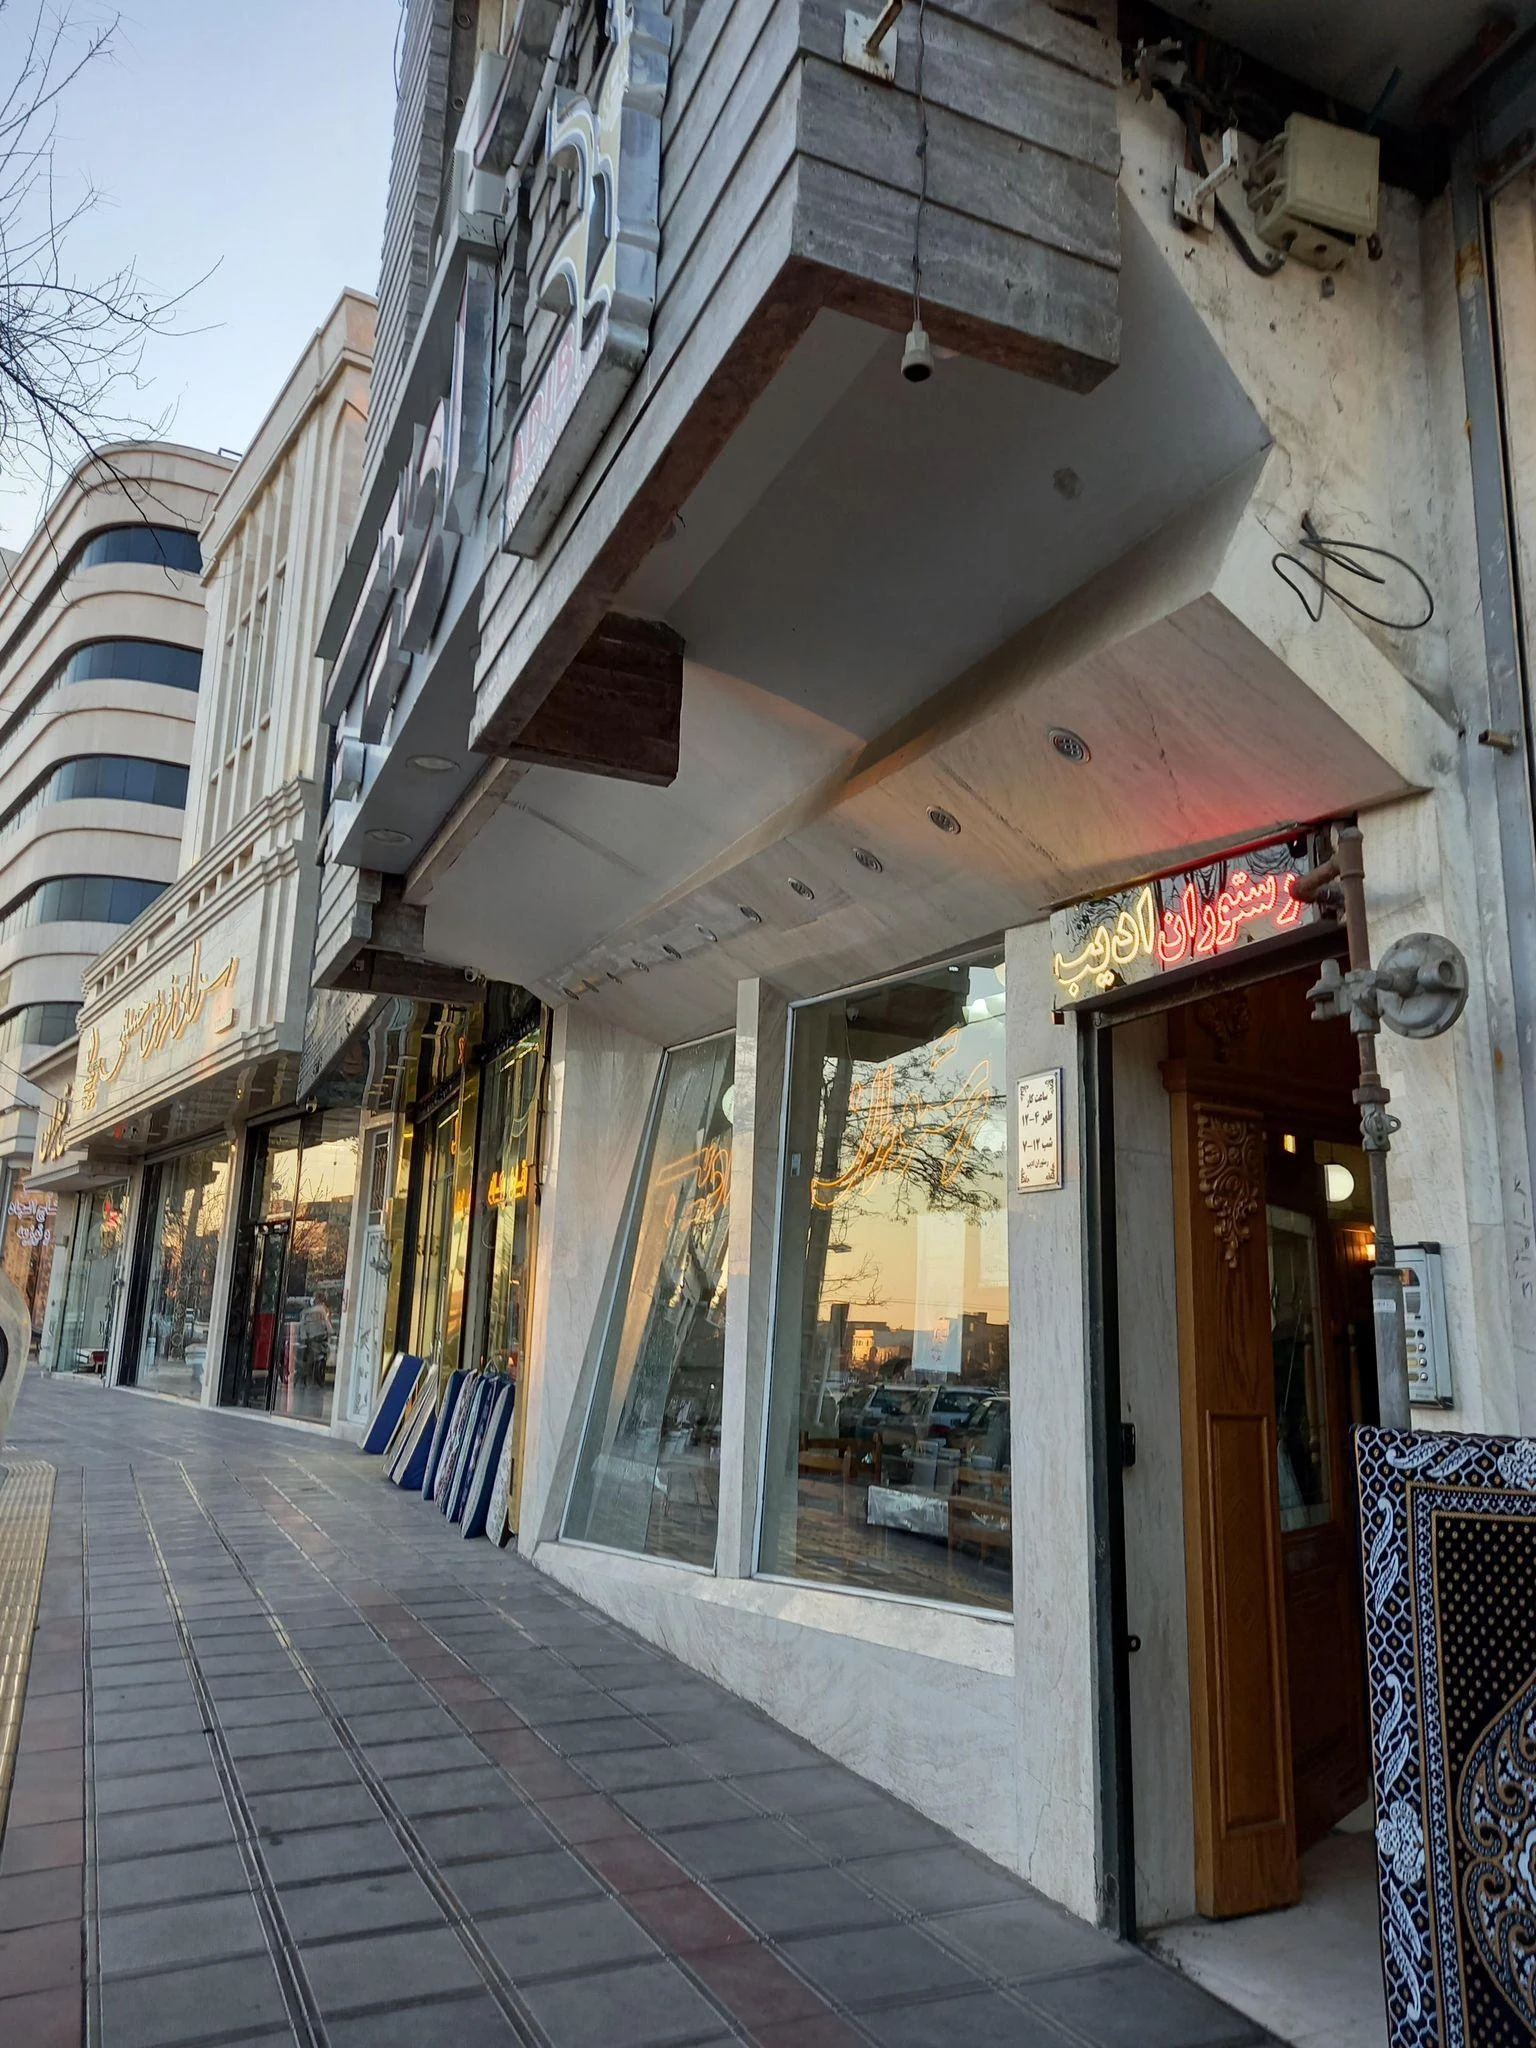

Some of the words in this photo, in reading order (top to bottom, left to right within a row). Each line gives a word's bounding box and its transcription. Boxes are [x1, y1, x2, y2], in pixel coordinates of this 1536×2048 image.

[1157, 871, 1301, 963] رستوران
[1053, 885, 1155, 998] ادیب
[1035, 1091, 1048, 1102] ساعت
[1041, 1109, 1053, 1126] ظهر
[1042, 1137, 1053, 1152] شب
